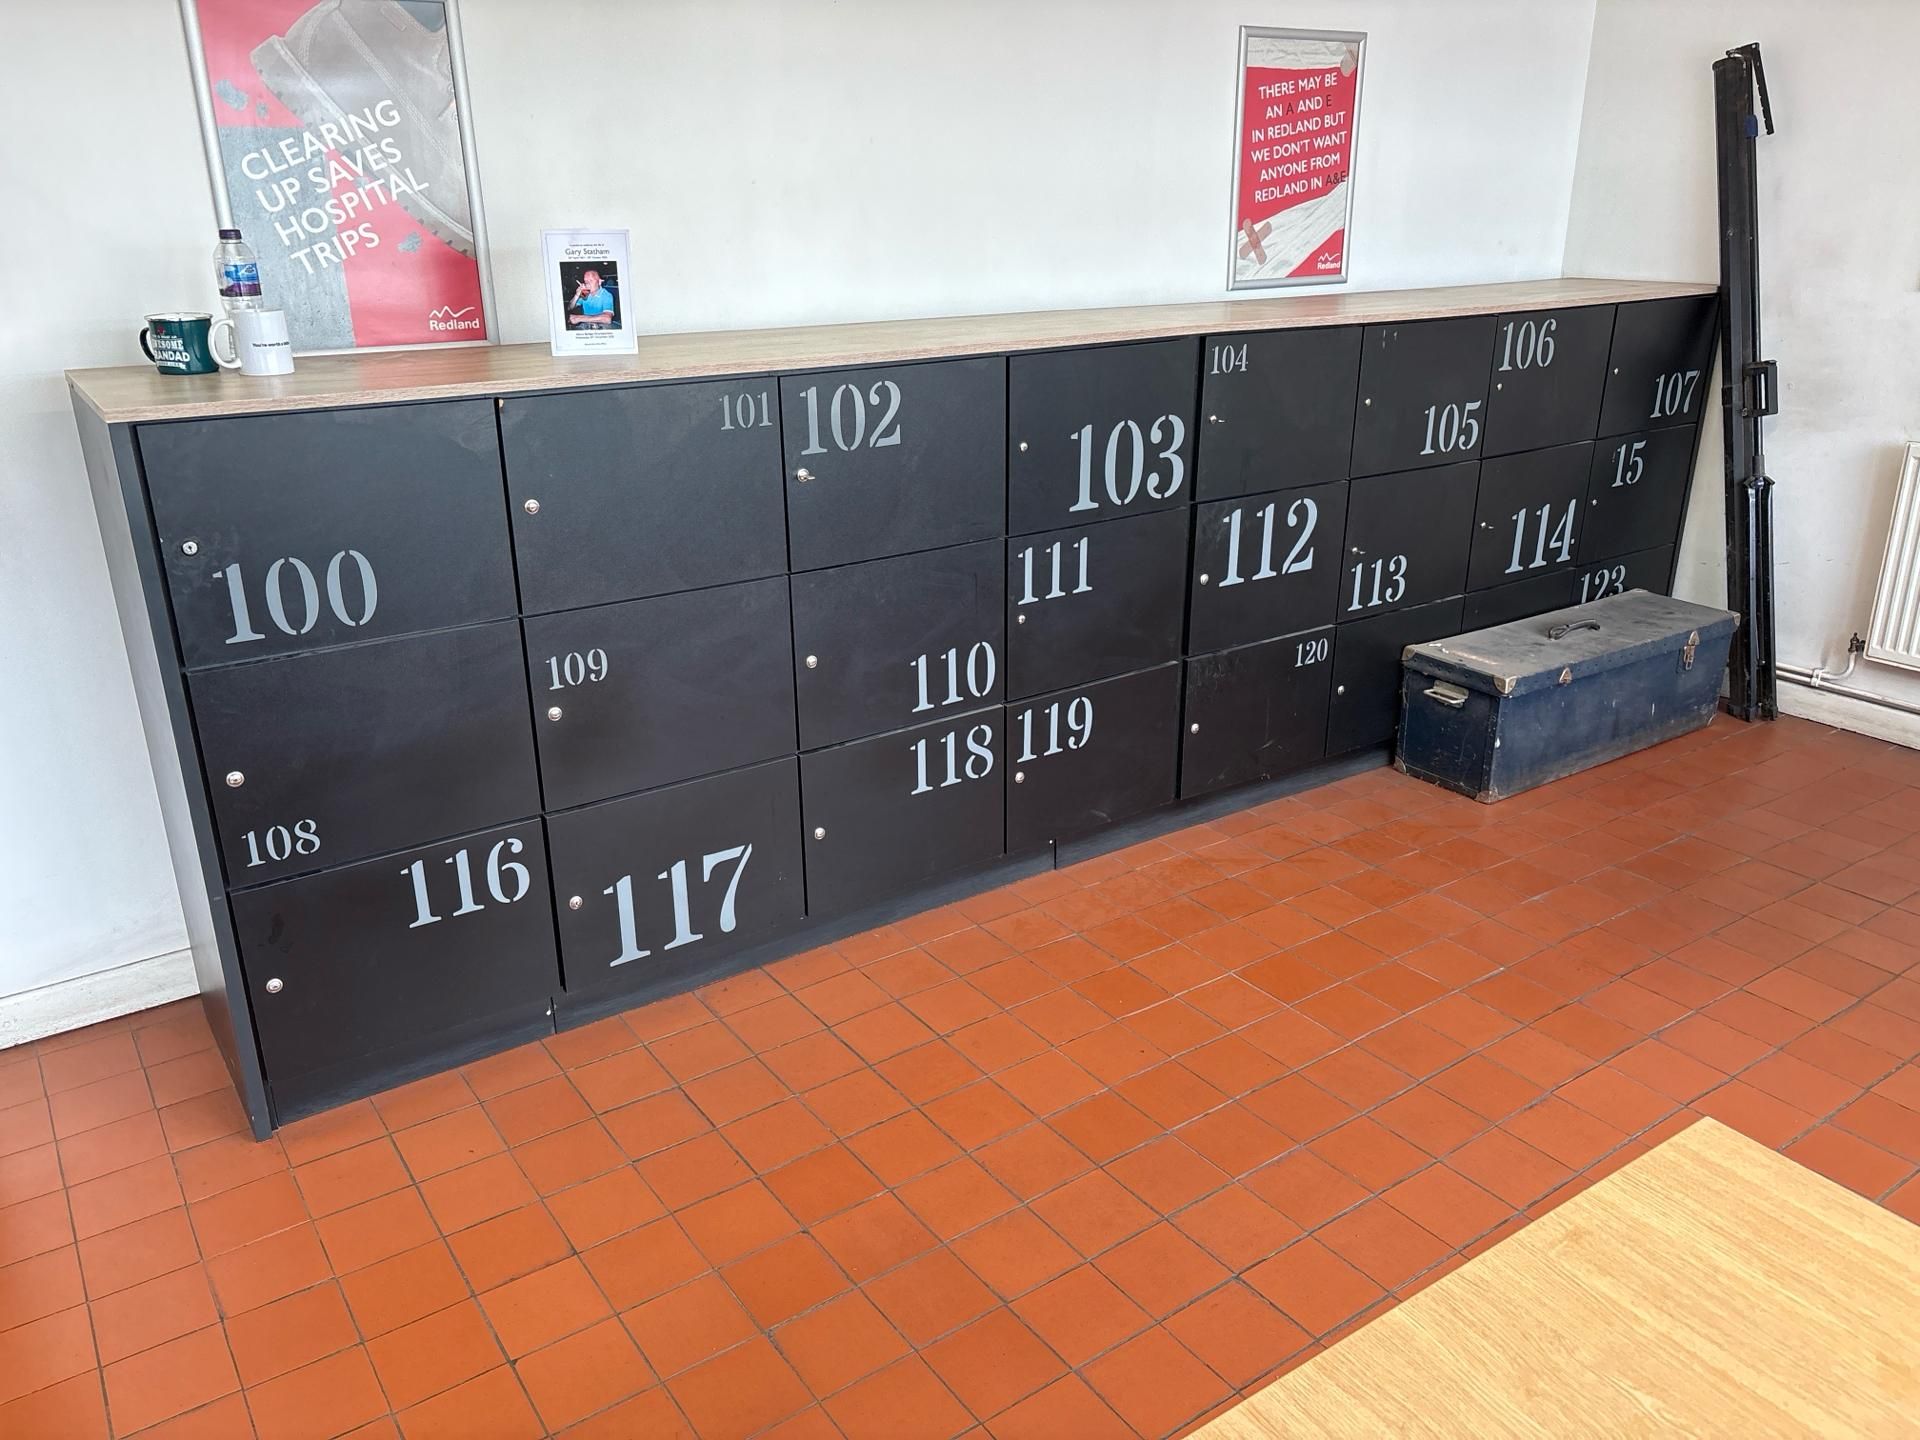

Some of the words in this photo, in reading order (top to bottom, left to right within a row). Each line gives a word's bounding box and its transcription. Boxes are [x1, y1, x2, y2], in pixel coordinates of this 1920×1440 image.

[1258, 80, 1295, 99] THERE
[1298, 75, 1321, 92] MAY
[1324, 72, 1338, 87] BE
[1265, 104, 1283, 120] AN
[1286, 102, 1294, 115] A
[1297, 96, 1323, 113] AND
[1326, 94, 1332, 107] E
[241, 99, 401, 180] CLEARING
[1251, 148, 1270, 163] WE
[1273, 139, 1310, 159] DON'T
[1313, 131, 1347, 149] WANT
[1252, 129, 1264, 143] IN
[1267, 117, 1321, 140] REDLAND
[1324, 111, 1346, 128] BUT
[256, 177, 300, 213] UP
[308, 137, 402, 193] SAVES
[1255, 180, 1308, 203] REDLAND
[1310, 176, 1322, 190] IN
[1325, 170, 1346, 187] A&E
[1260, 160, 1308, 182] ANYONE
[1310, 152, 1340, 170] FROM
[274, 167, 429, 246] HOSPITAL
[290, 222, 380, 275] TRIPS
[565, 248, 581, 256] Gary
[1317, 260, 1341, 270] Redland
[429, 317, 480, 331] Redland
[1499, 319, 1556, 371] 106
[1210, 343, 1249, 375] 104
[721, 392, 772, 430] 101
[800, 381, 900, 454] 102
[1650, 371, 1700, 418] 107
[1420, 400, 1481, 454] 105
[1070, 415, 1184, 511] 103
[1219, 498, 1317, 587] 112
[1505, 499, 1576, 573] 114
[213, 550, 377, 644] 100
[1018, 537, 1092, 605] 111
[1348, 552, 1406, 611] 113
[1581, 565, 1626, 604] 123
[546, 649, 607, 689] 109
[910, 641, 996, 713] 110
[1294, 638, 1328, 667] 120
[1017, 697, 1092, 762] 119
[910, 725, 993, 794] 118
[242, 820, 320, 867] 108
[401, 838, 529, 928] 116
[604, 844, 752, 967] 117
